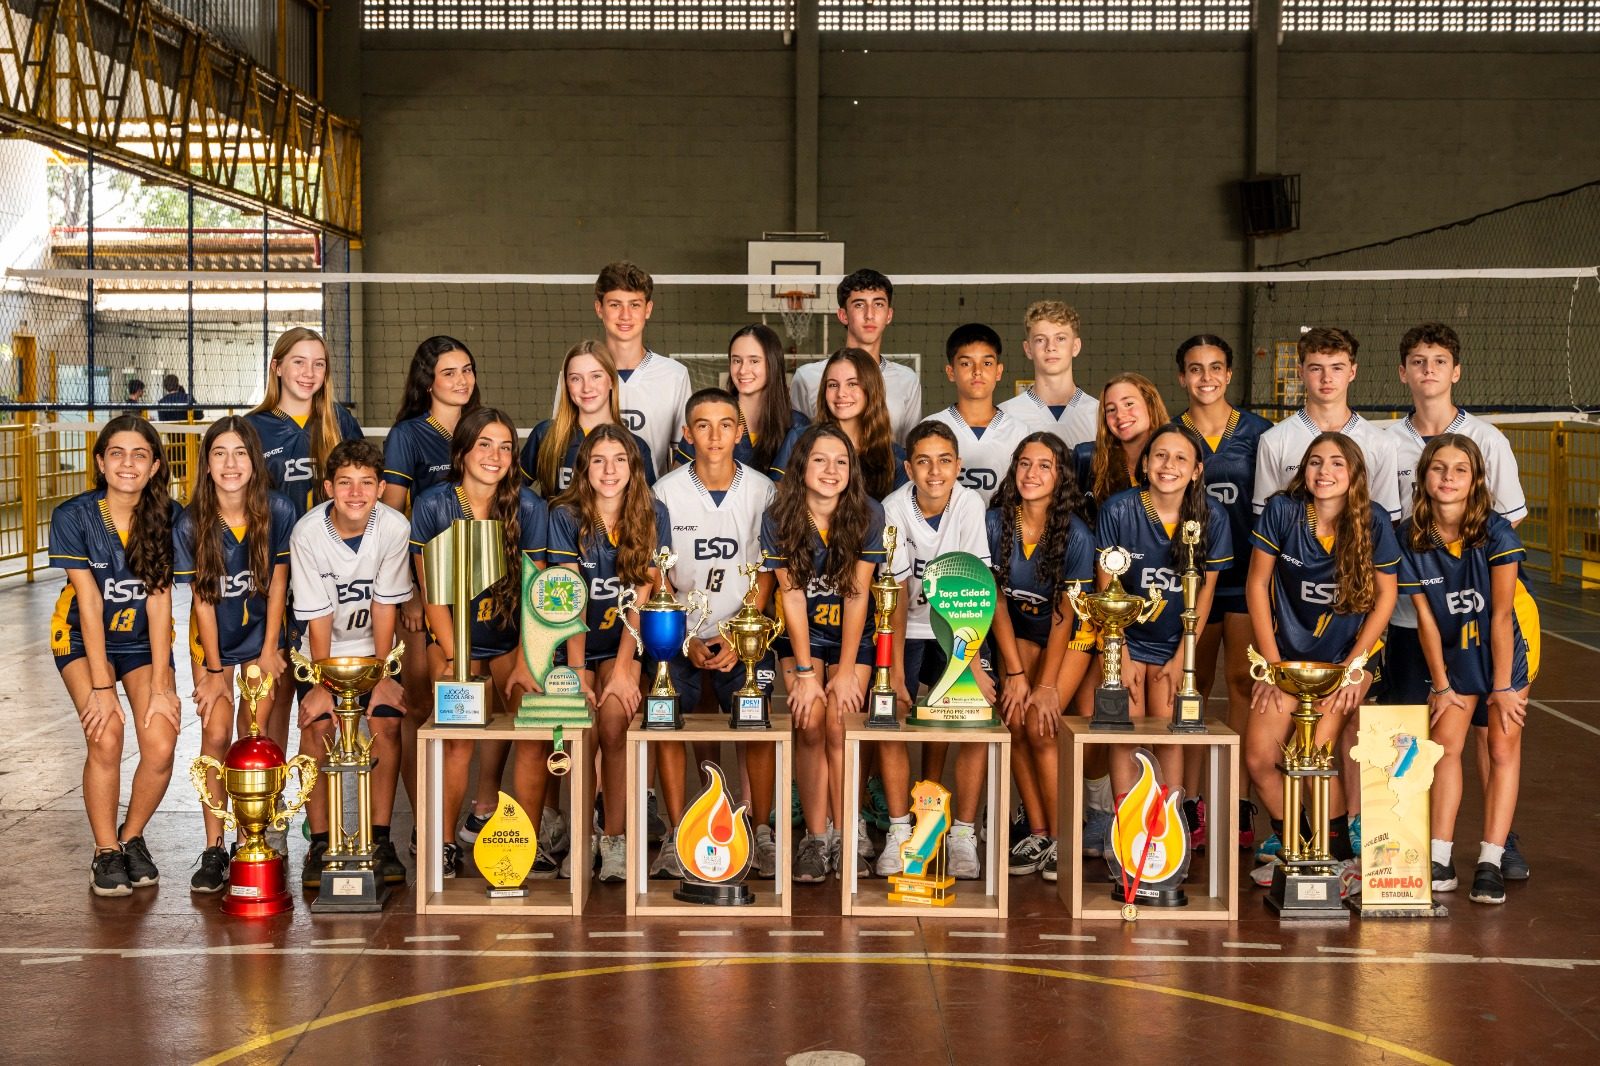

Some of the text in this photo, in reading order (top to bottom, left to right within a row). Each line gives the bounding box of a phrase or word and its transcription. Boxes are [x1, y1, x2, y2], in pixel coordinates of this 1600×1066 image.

[284, 457, 317, 482] ES
[1204, 482, 1239, 505] SD
[695, 536, 739, 561] ESD
[705, 567, 725, 592] 13
[939, 589, 991, 599] Taça Cidade
[939, 600, 950, 609] do
[953, 600, 978, 608] Verde
[1446, 588, 1486, 615] ESD
[109, 607, 136, 631] 13
[346, 609, 370, 631] 10
[598, 606, 619, 630] 9
[814, 604, 841, 626] 20
[948, 610, 983, 619] Voleibol
[1461, 620, 1480, 650] 14
[1369, 876, 1424, 889] CAMPEÃO
